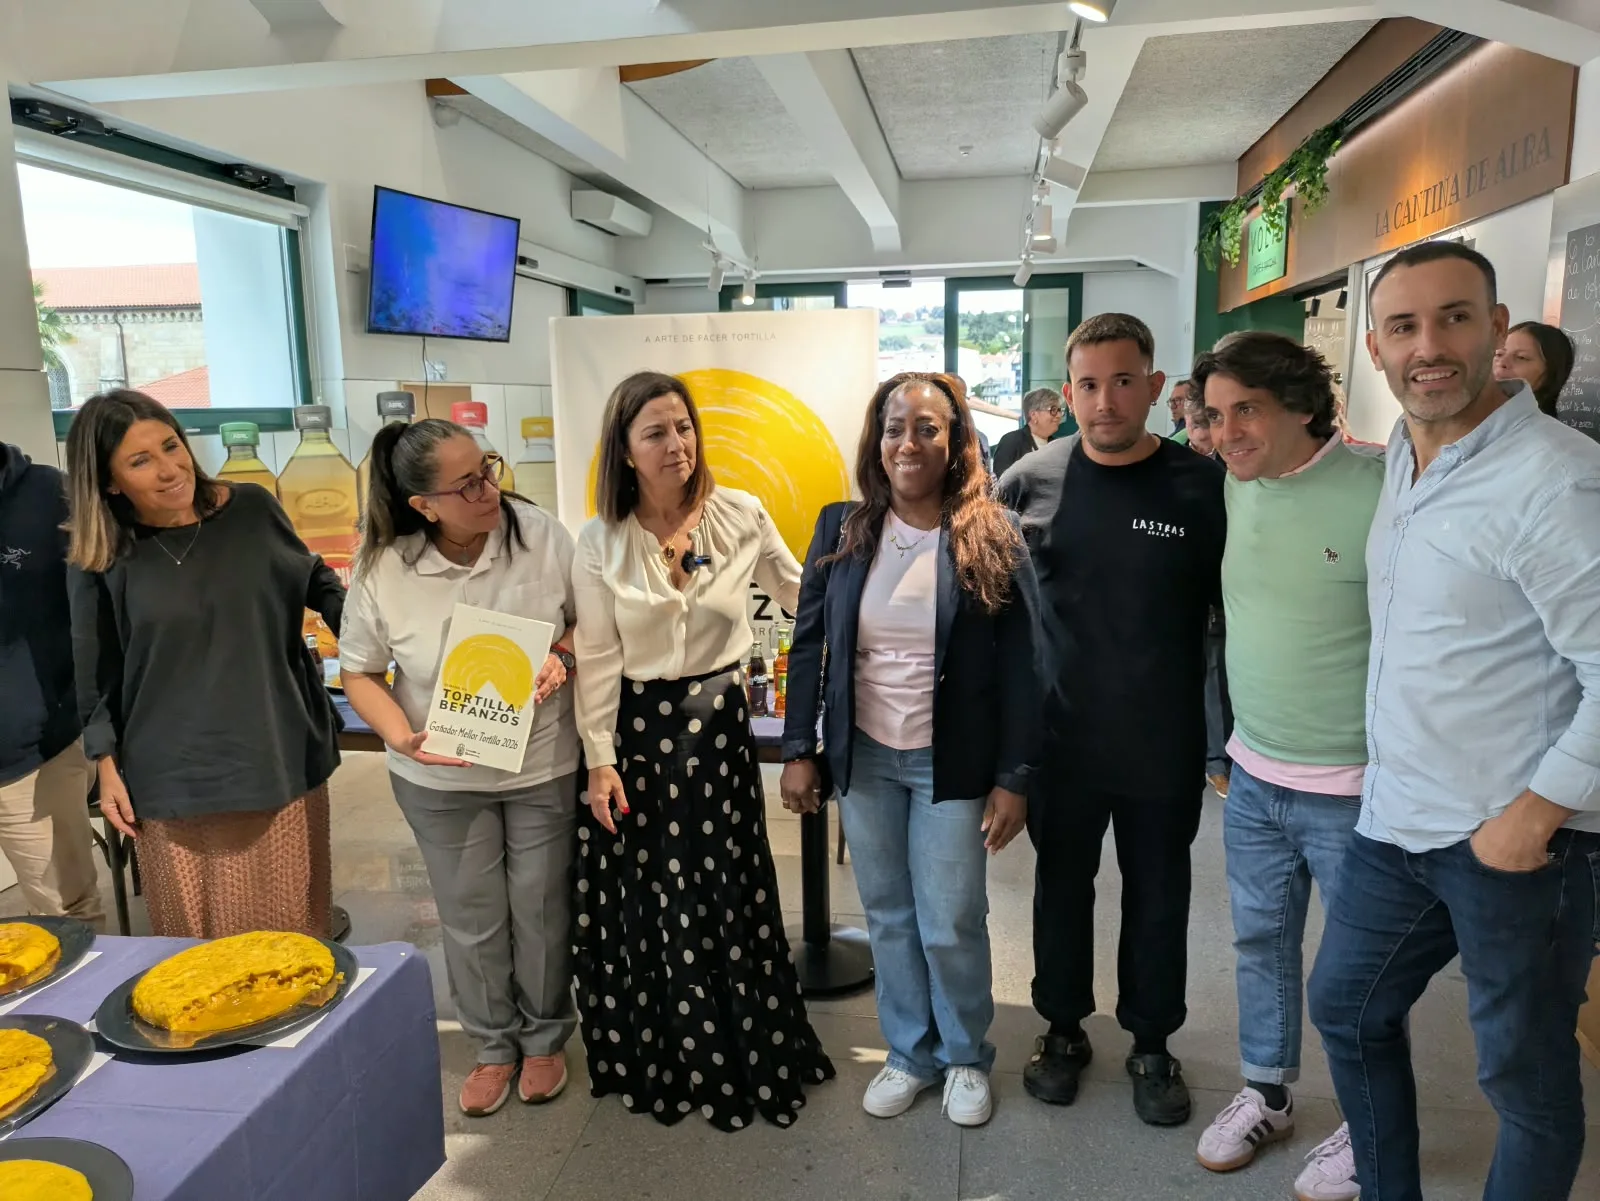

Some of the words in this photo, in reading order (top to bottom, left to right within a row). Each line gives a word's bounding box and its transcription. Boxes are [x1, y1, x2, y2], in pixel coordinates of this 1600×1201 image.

[1374, 208, 1390, 239] LA
[1393, 172, 1460, 230] CANTINA
[1465, 157, 1490, 199] DE
[1494, 126, 1554, 185] ALBA
[655, 335, 680, 343] ARTE
[682, 334, 695, 343] DE
[698, 333, 728, 342] FACER
[731, 332, 777, 342] TORTILLA
[1132, 518, 1185, 537] LASTRAS
[439, 699, 520, 727] BETANZOS
[442, 688, 516, 714] TORTILLA
[458, 727, 478, 741] Mellor
[479, 731, 502, 746] Tortilla
[501, 737, 519, 750] 2026
